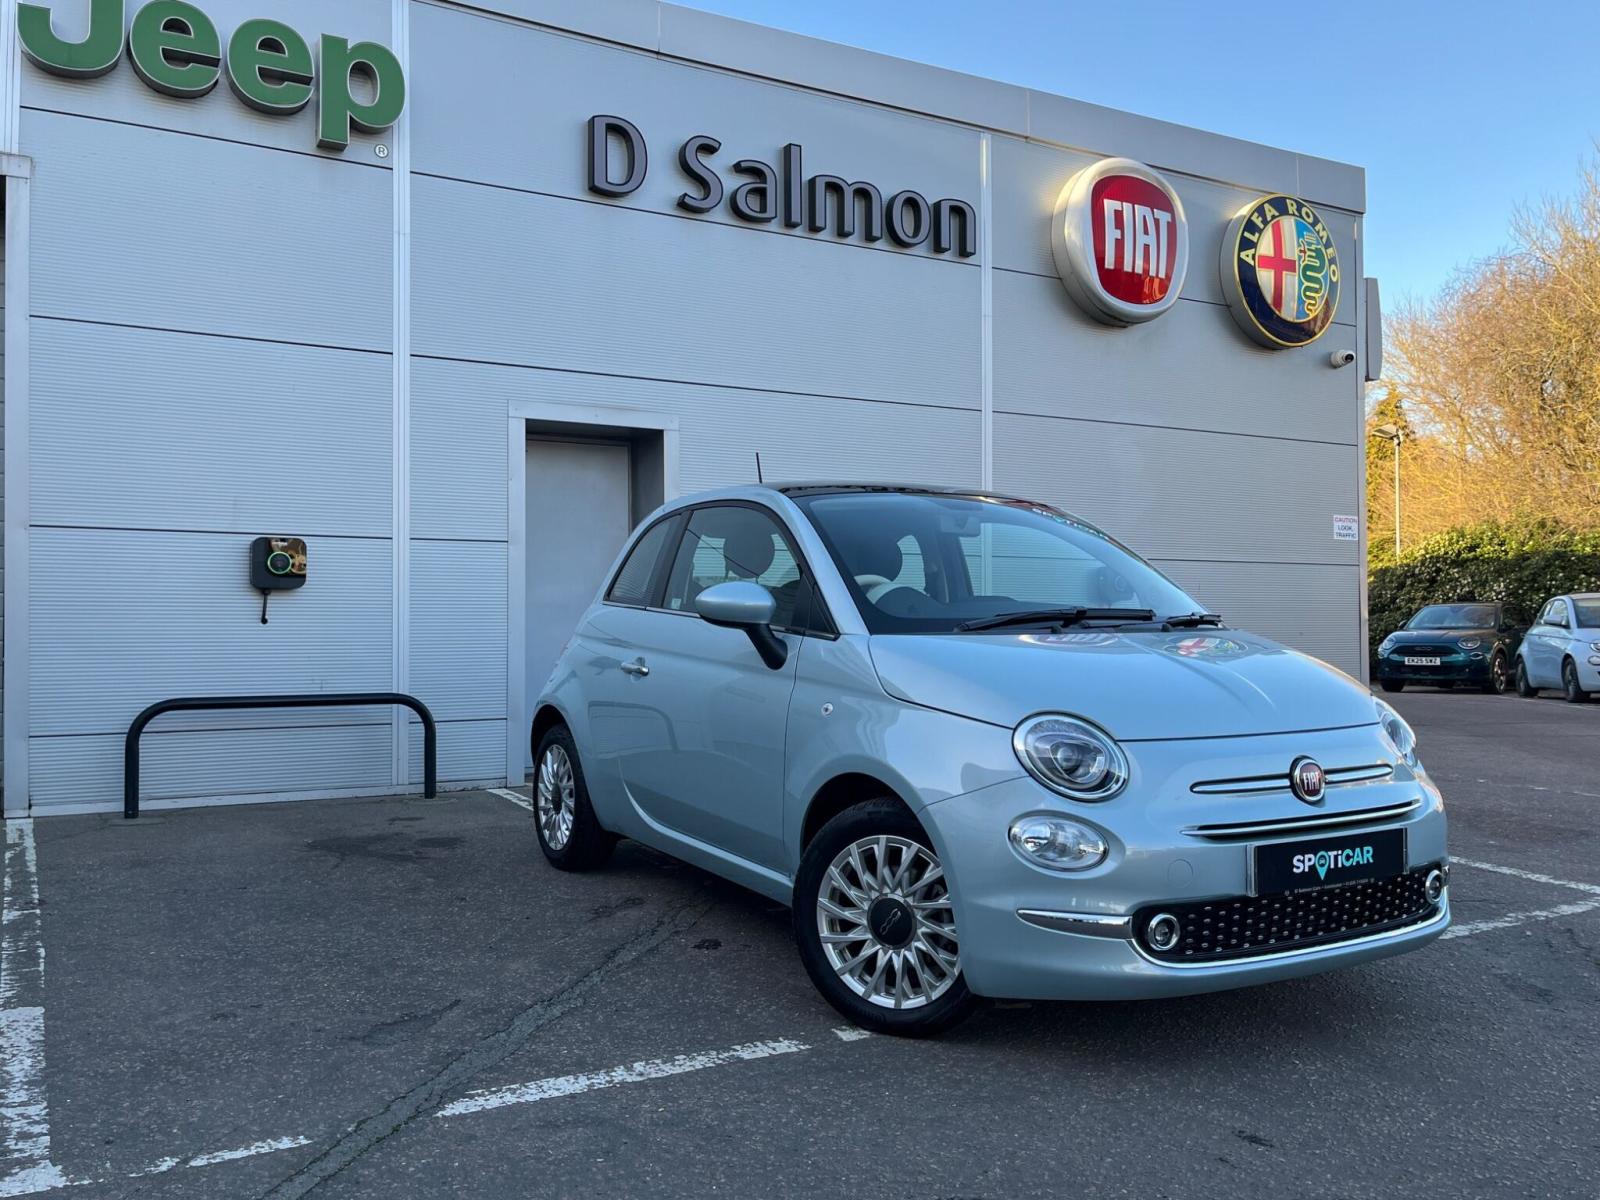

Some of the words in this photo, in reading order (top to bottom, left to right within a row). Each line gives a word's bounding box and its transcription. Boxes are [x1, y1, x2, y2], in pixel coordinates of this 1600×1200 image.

[16, 0, 406, 150] Jeep
[588, 114, 648, 197] D
[676, 134, 977, 258] Salmon
[1103, 198, 1172, 279] FIAT
[1240, 205, 1279, 266] ALFA
[1286, 197, 1338, 283] ROMEO
[1302, 771, 1321, 791] FIAT
